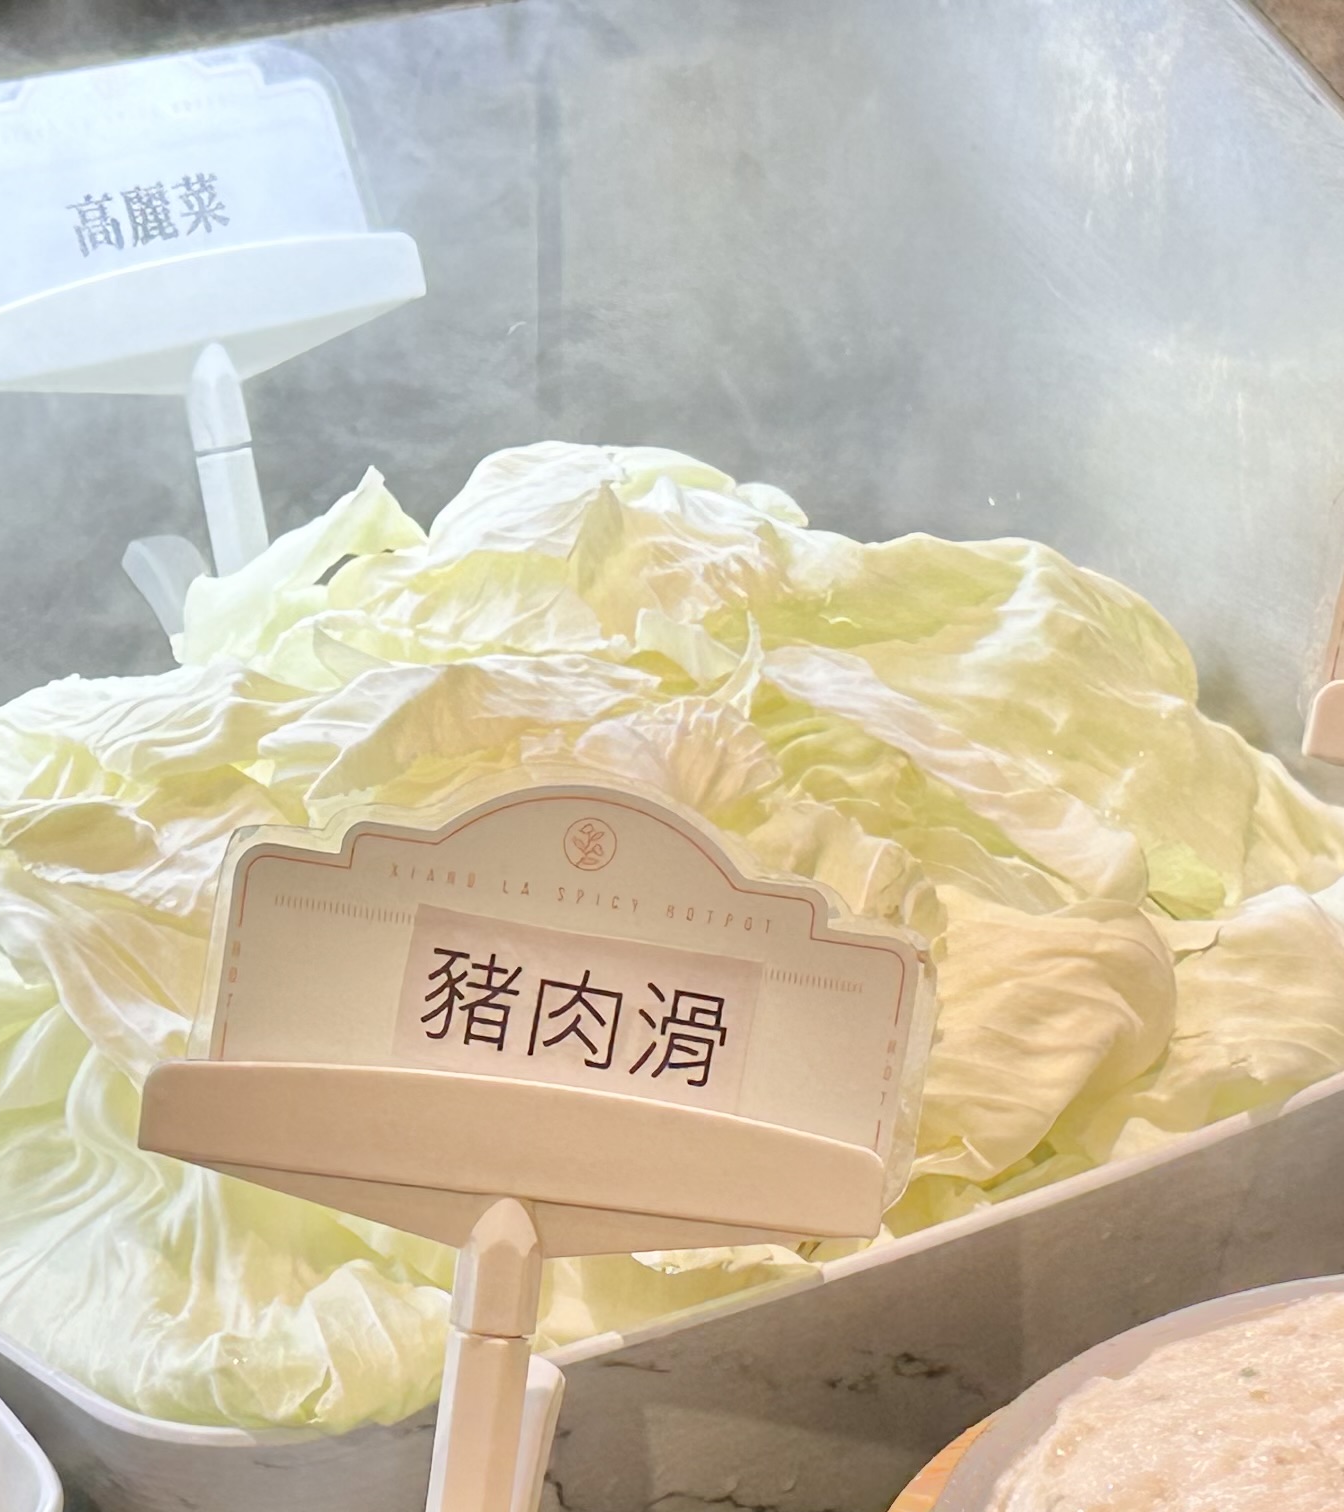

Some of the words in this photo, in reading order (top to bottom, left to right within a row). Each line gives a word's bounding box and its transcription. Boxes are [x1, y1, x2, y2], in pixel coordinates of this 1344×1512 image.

[66, 172, 231, 257] 高麗菜
[419, 946, 728, 1088] 豬肉滑
